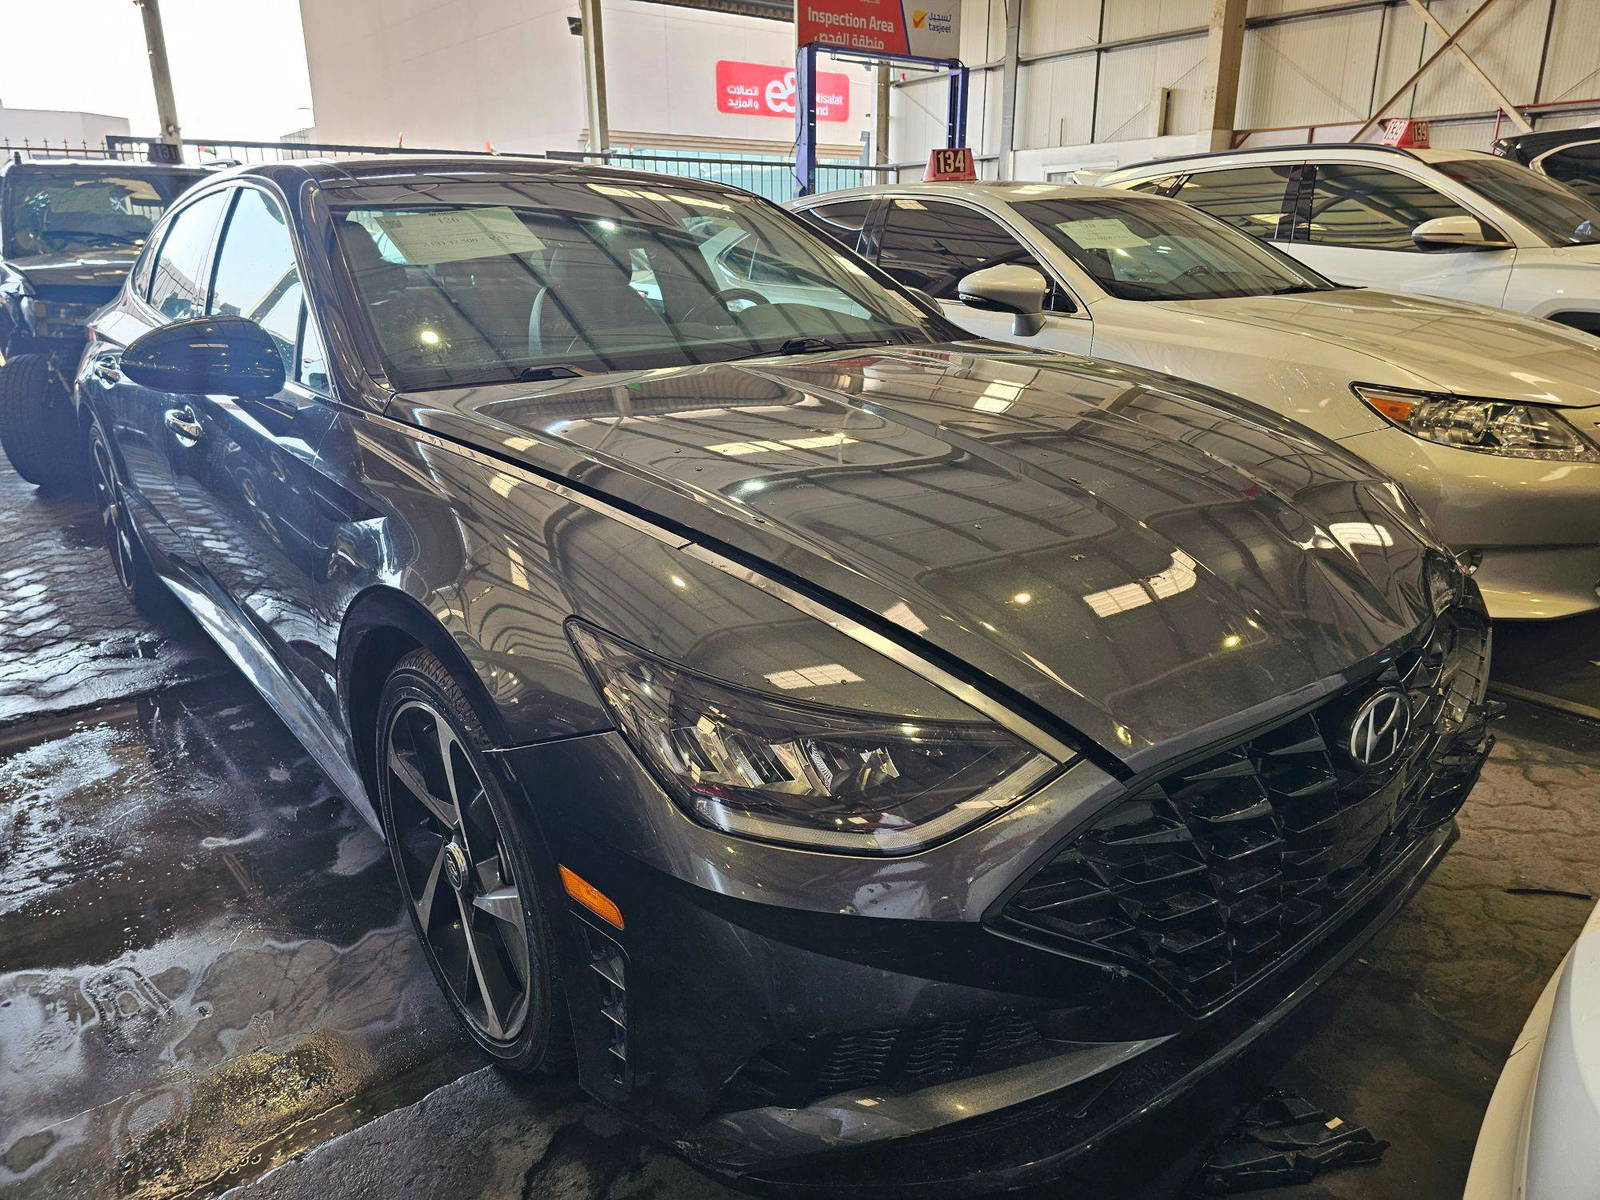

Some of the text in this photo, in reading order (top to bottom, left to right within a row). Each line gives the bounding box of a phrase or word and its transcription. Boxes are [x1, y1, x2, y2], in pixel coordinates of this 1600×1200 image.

[808, 7, 894, 32] Inspection Area
[928, 22, 952, 34] tasjeel
[852, 34, 884, 49] منطقة
[727, 85, 759, 96] اتصالات
[816, 93, 843, 105] tisalat
[816, 106, 829, 116] nd
[1384, 120, 1408, 140] 139
[1414, 122, 1428, 141] 139
[938, 151, 964, 173] 134
